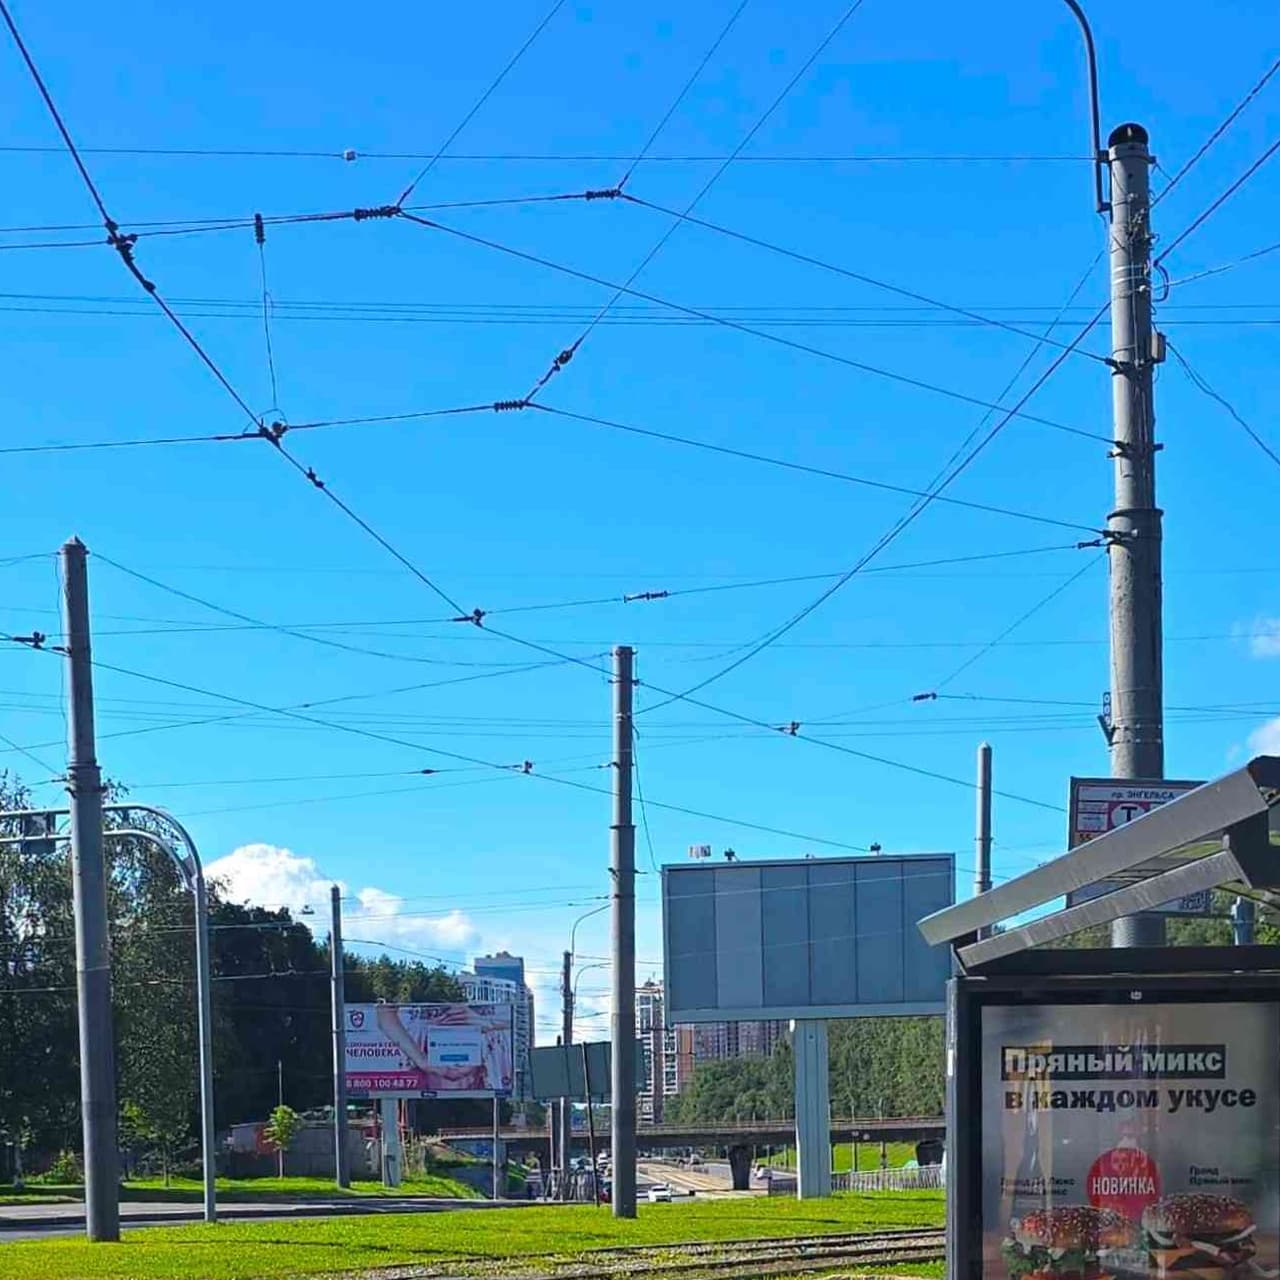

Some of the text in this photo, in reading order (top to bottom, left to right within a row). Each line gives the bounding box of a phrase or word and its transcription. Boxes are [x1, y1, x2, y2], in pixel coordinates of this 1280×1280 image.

[346, 1047, 402, 1058] ЧЕЛОВЕКА
[1005, 1046, 1223, 1078] Пряный микс
[374, 1079, 390, 1088] 100
[1005, 1087, 1257, 1114] в каждом укусе
[1092, 1176, 1156, 1196] НОВИНКА
